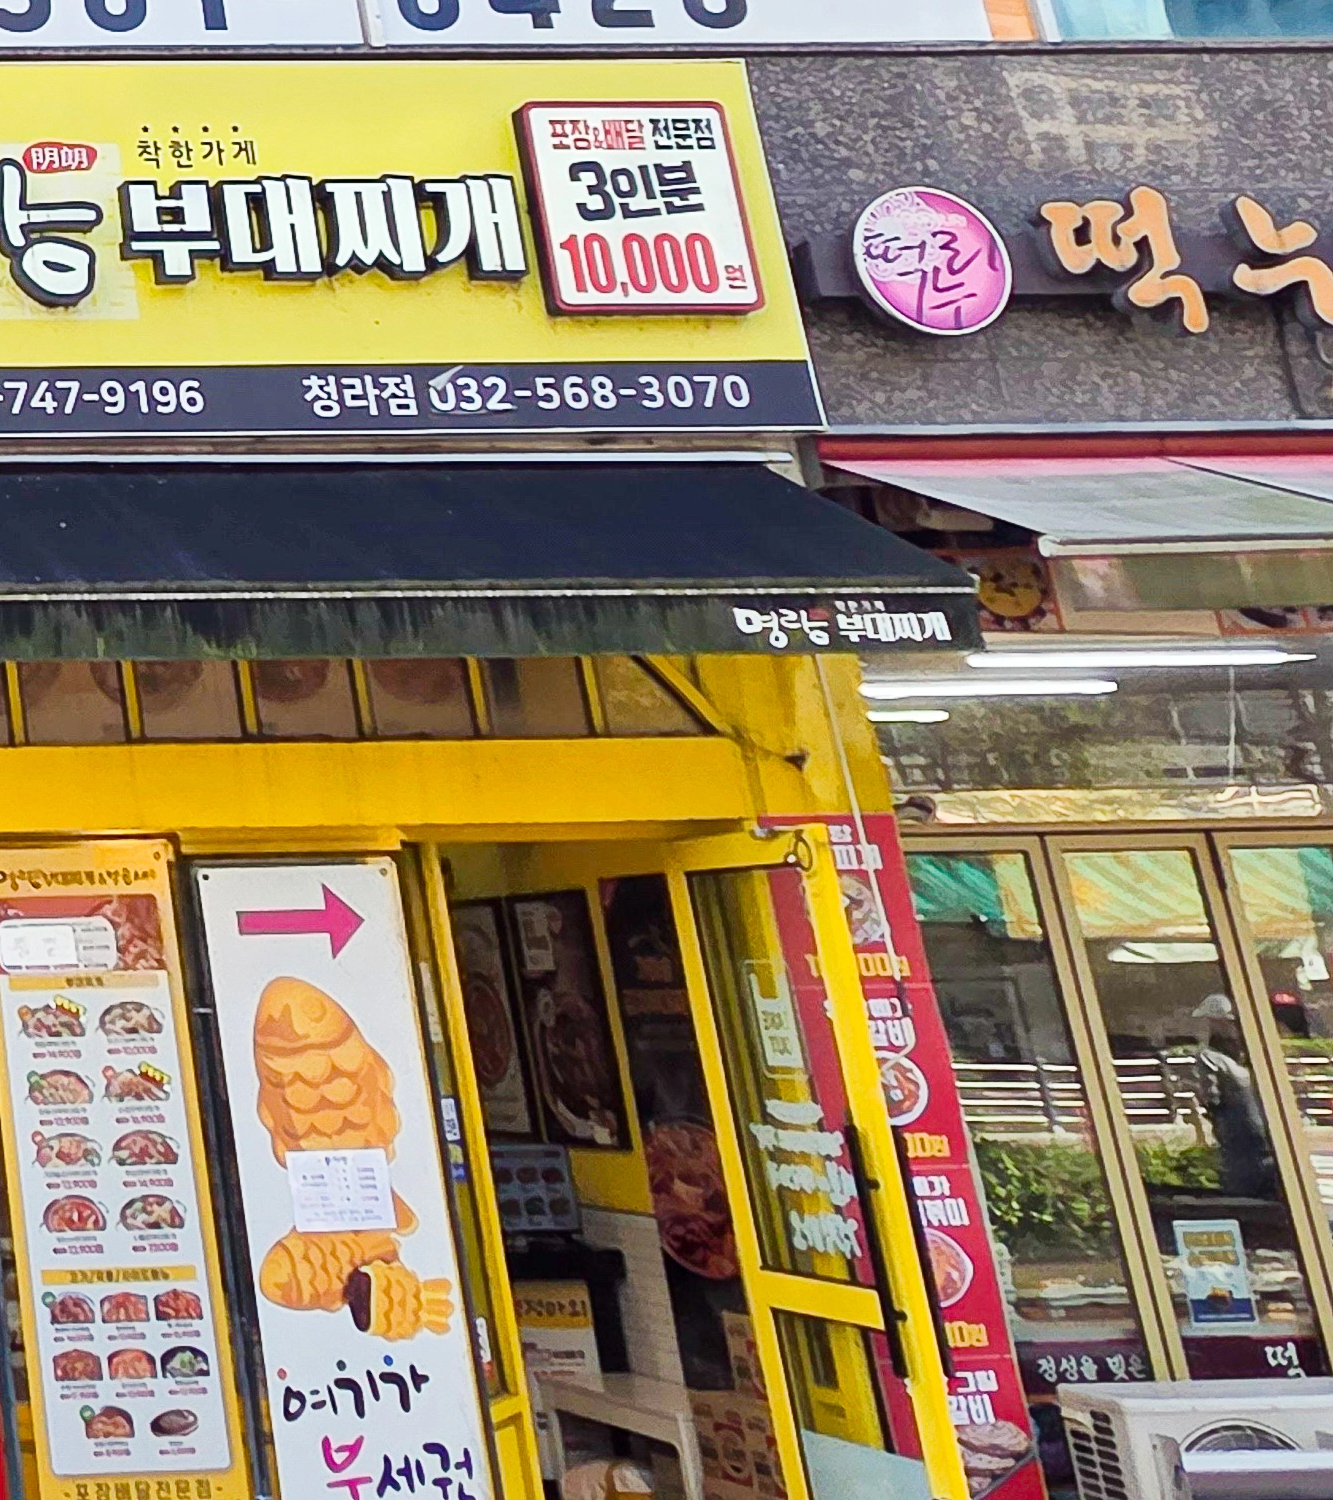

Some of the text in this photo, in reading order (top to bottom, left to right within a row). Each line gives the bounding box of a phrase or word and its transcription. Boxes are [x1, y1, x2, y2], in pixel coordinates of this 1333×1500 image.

[648, 117, 717, 150] 전문점
[569, 159, 706, 222] 3인분
[121, 173, 529, 284] 부대찌개
[302, 373, 417, 418] 청라점
[429, 374, 751, 413] 032-568-3070
[733, 606, 952, 649] 명랑 부대찌개
[283, 1363, 430, 1422] 여기가
